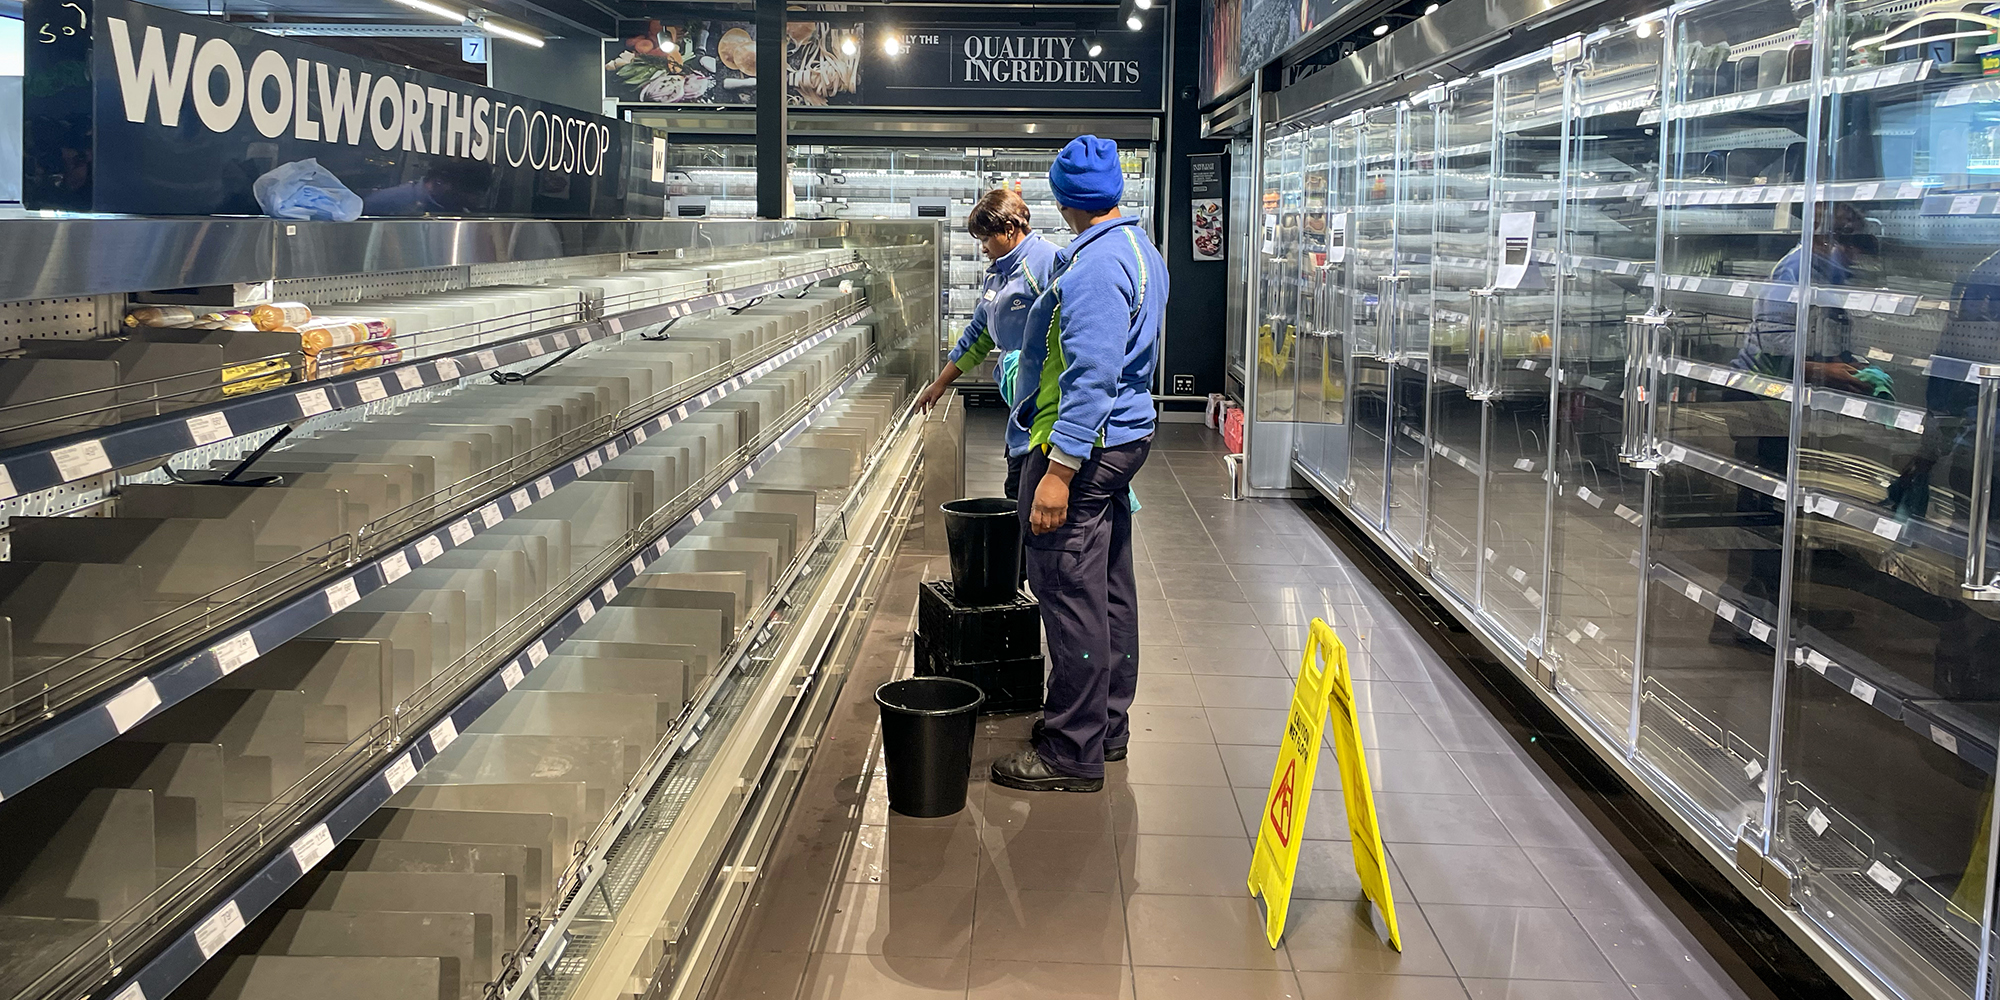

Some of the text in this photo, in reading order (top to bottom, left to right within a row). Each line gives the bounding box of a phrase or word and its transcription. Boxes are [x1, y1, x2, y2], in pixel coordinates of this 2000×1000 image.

[469, 43, 479, 57] 7
[919, 35, 939, 45] THE
[963, 36, 1076, 63] QUALITY
[963, 59, 1140, 84] INGREDIENTS
[107, 16, 610, 177] WOOLWORTHS FOODSTOP
[655, 150, 664, 170] W
[1294, 711, 1309, 746] CAUTION
[1289, 722, 1309, 765] WET FLOOR
